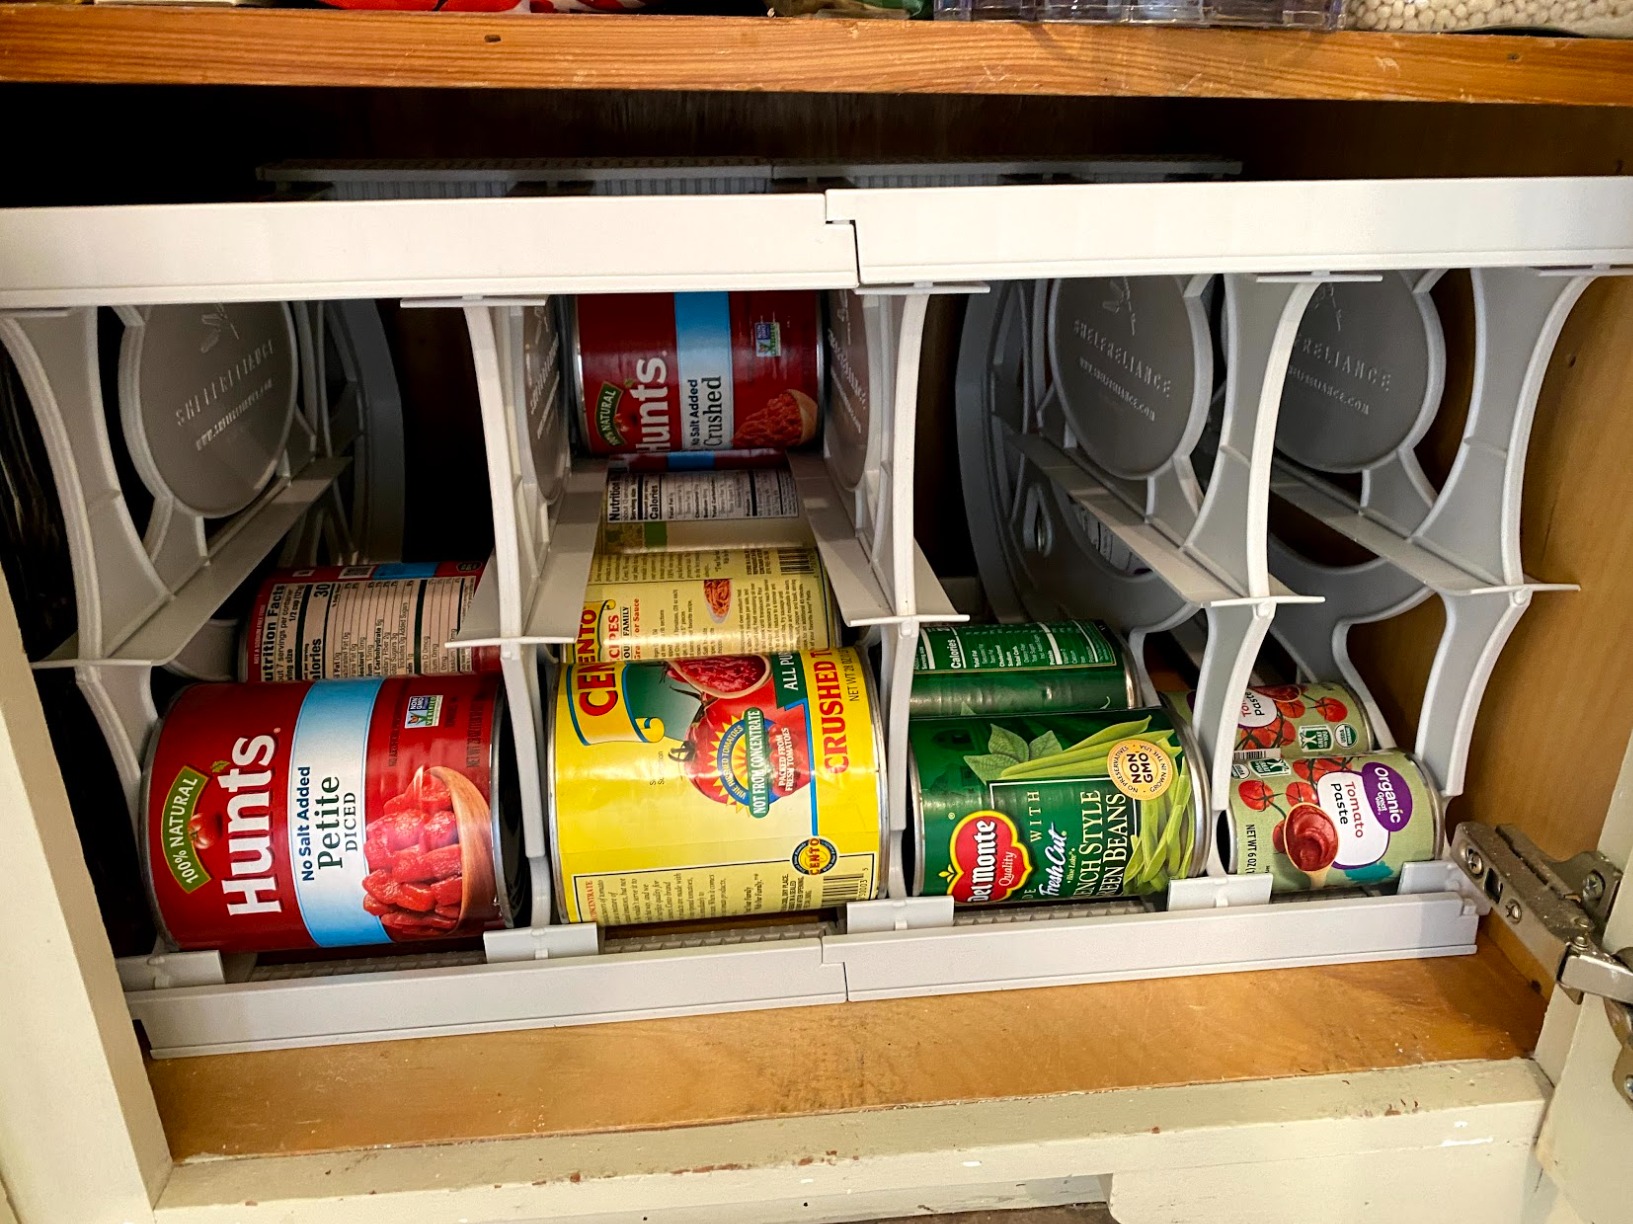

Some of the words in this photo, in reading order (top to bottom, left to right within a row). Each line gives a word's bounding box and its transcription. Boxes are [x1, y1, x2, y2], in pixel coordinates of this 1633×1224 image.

[600, 390, 617, 431] NATURAL
[688, 379, 699, 418] Added
[701, 376, 723, 447] Crushed
[690, 421, 700, 437] Salt
[649, 485, 659, 520] Calories
[267, 585, 285, 617] Facts
[281, 588, 293, 616] container
[313, 583, 331, 598] 30
[288, 611, 297, 622] 1/2
[291, 599, 299, 611] cup
[622, 606, 630, 636] FAMILY
[634, 624, 640, 633] or
[278, 630, 289, 661] servings
[374, 627, 382, 671] Carbohydrate
[577, 609, 597, 663] ENTO
[263, 622, 276, 681] utrition
[285, 648, 293, 664] size
[310, 638, 322, 680] alories
[946, 639, 962, 669] Calories
[994, 644, 1005, 668] Cholesterol
[577, 662, 619, 717] CEN
[782, 667, 799, 691] ALL
[844, 673, 857, 684] WT
[410, 697, 418, 710] NON
[416, 697, 424, 710] GMO
[847, 686, 859, 702] NET
[813, 660, 850, 774] CRUSHED
[721, 725, 744, 757] TOMATOES
[747, 710, 764, 768] CONCENTRATE
[775, 735, 785, 756] FROM
[781, 727, 795, 766] TOMATOES
[1139, 745, 1153, 753] USA
[1316, 731, 1324, 749] GREAT
[1339, 729, 1347, 744] USDA
[1113, 745, 1129, 786] PRESERVATIVES
[1126, 753, 1143, 784] NON
[1138, 752, 1154, 783] GMO
[1153, 751, 1163, 762] THE
[1161, 763, 1167, 771] IN
[750, 768, 765, 793] FROM
[777, 756, 787, 786] PACKED
[785, 767, 795, 791] FRESH
[1150, 771, 1167, 792] GROWN
[295, 766, 311, 820] Added
[732, 785, 747, 800] VINE
[1127, 785, 1139, 793] NO
[1374, 767, 1404, 823] Organic
[168, 777, 198, 847] NATURAL
[752, 795, 766, 815] NOT
[1026, 791, 1043, 842] WITH
[1330, 783, 1349, 825] Paste
[1344, 781, 1365, 838] Tomato
[212, 727, 283, 916] Hunt's
[314, 775, 343, 870] Petite
[342, 791, 358, 852] DICED
[1078, 790, 1104, 855] STYLE
[1102, 793, 1128, 863] BEANS
[1246, 824, 1256, 838] NET
[296, 825, 311, 857] Salt
[971, 820, 997, 884] Monte
[1044, 821, 1067, 866] Cut
[1246, 839, 1257, 852] WT
[172, 850, 200, 884] 100%
[300, 859, 315, 881] No
[809, 838, 821, 876] CENTO
[998, 851, 1018, 887] Quality
[1246, 858, 1256, 867] OZ
[597, 880, 606, 897] tomato
[619, 878, 628, 887] not
[643, 883, 650, 891] we
[651, 880, 662, 889] for
[663, 881, 671, 896] brand
[673, 873, 682, 885] with
[1038, 865, 1065, 896] Fresh
[1066, 868, 1076, 881] Blue
[1073, 858, 1102, 896] ENCH
[1096, 866, 1125, 896] REEN
[619, 887, 628, 896] but
[631, 890, 640, 902] serve
[643, 892, 651, 900] and
[674, 884, 683, 898] made
[967, 883, 993, 902] Del
[1021, 888, 1037, 900] DE
